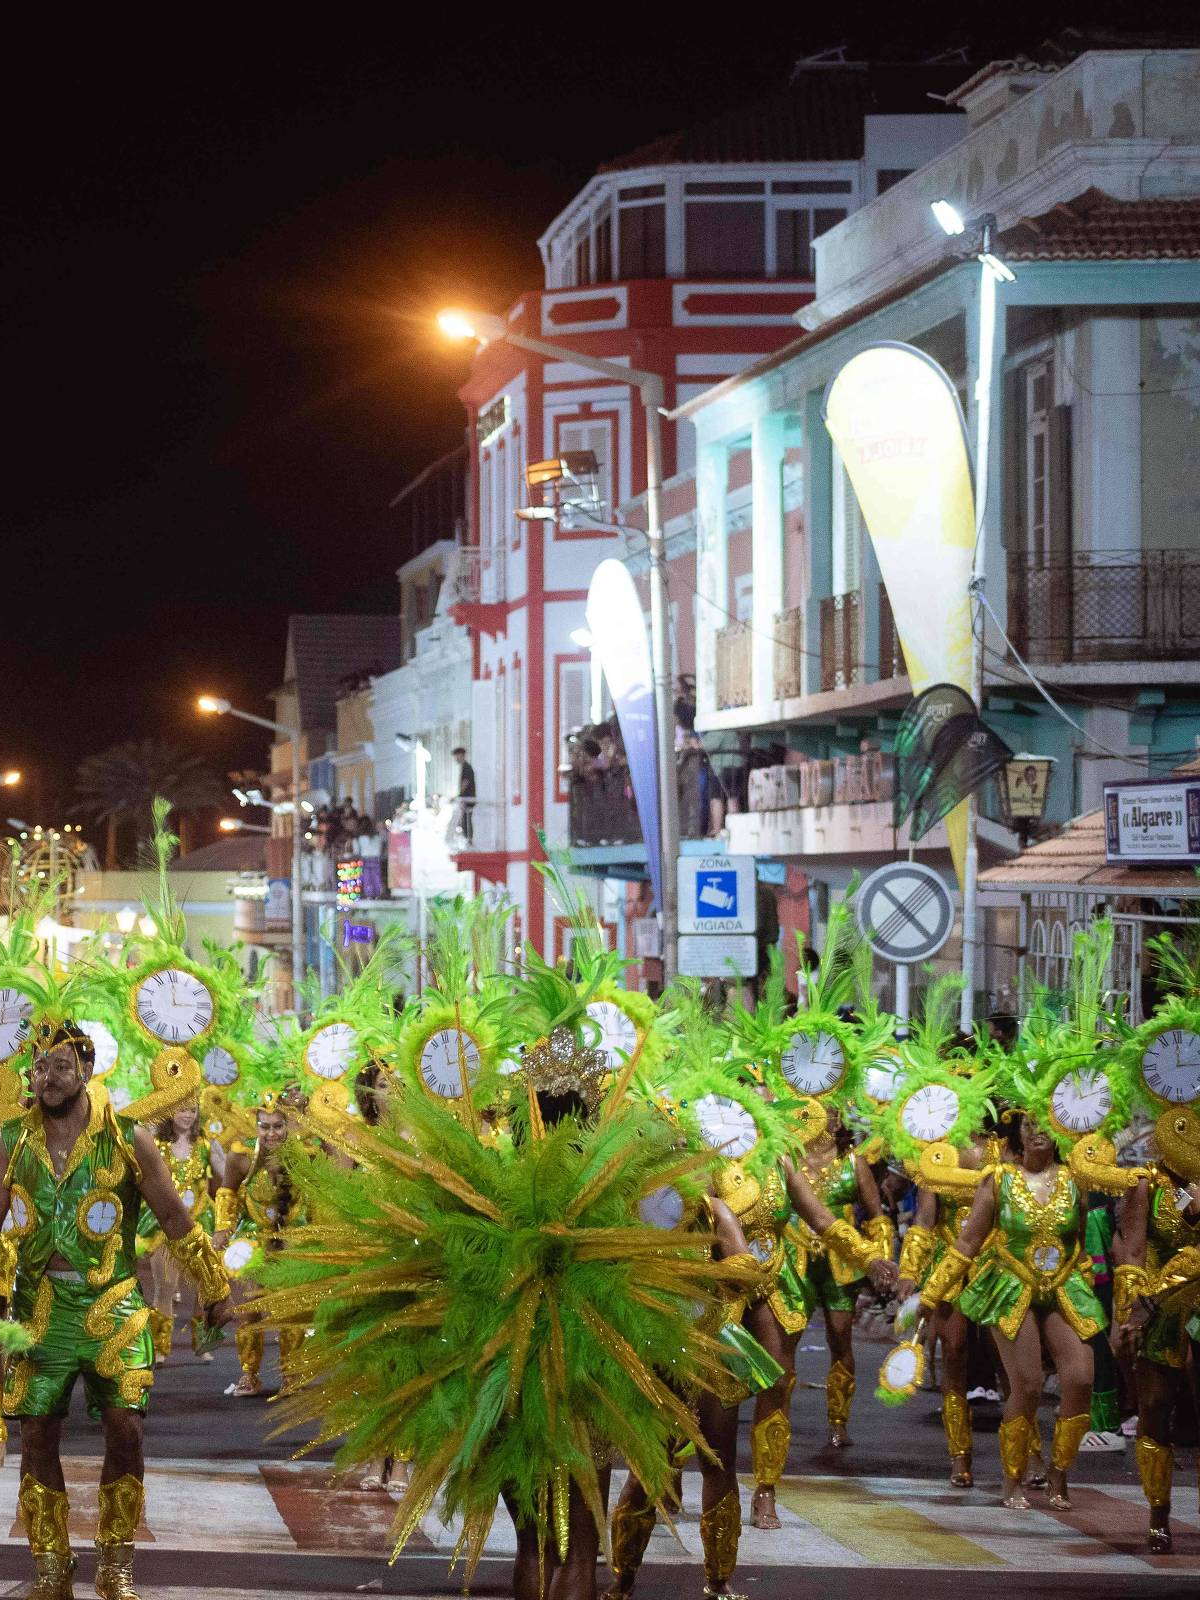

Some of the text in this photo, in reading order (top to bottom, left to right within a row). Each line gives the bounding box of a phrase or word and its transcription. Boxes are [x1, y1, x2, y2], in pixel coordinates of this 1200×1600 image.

[1131, 806, 1173, 833] Algarve
[700, 859, 732, 869] ZONA
[693, 920, 743, 931] VIGIADA
